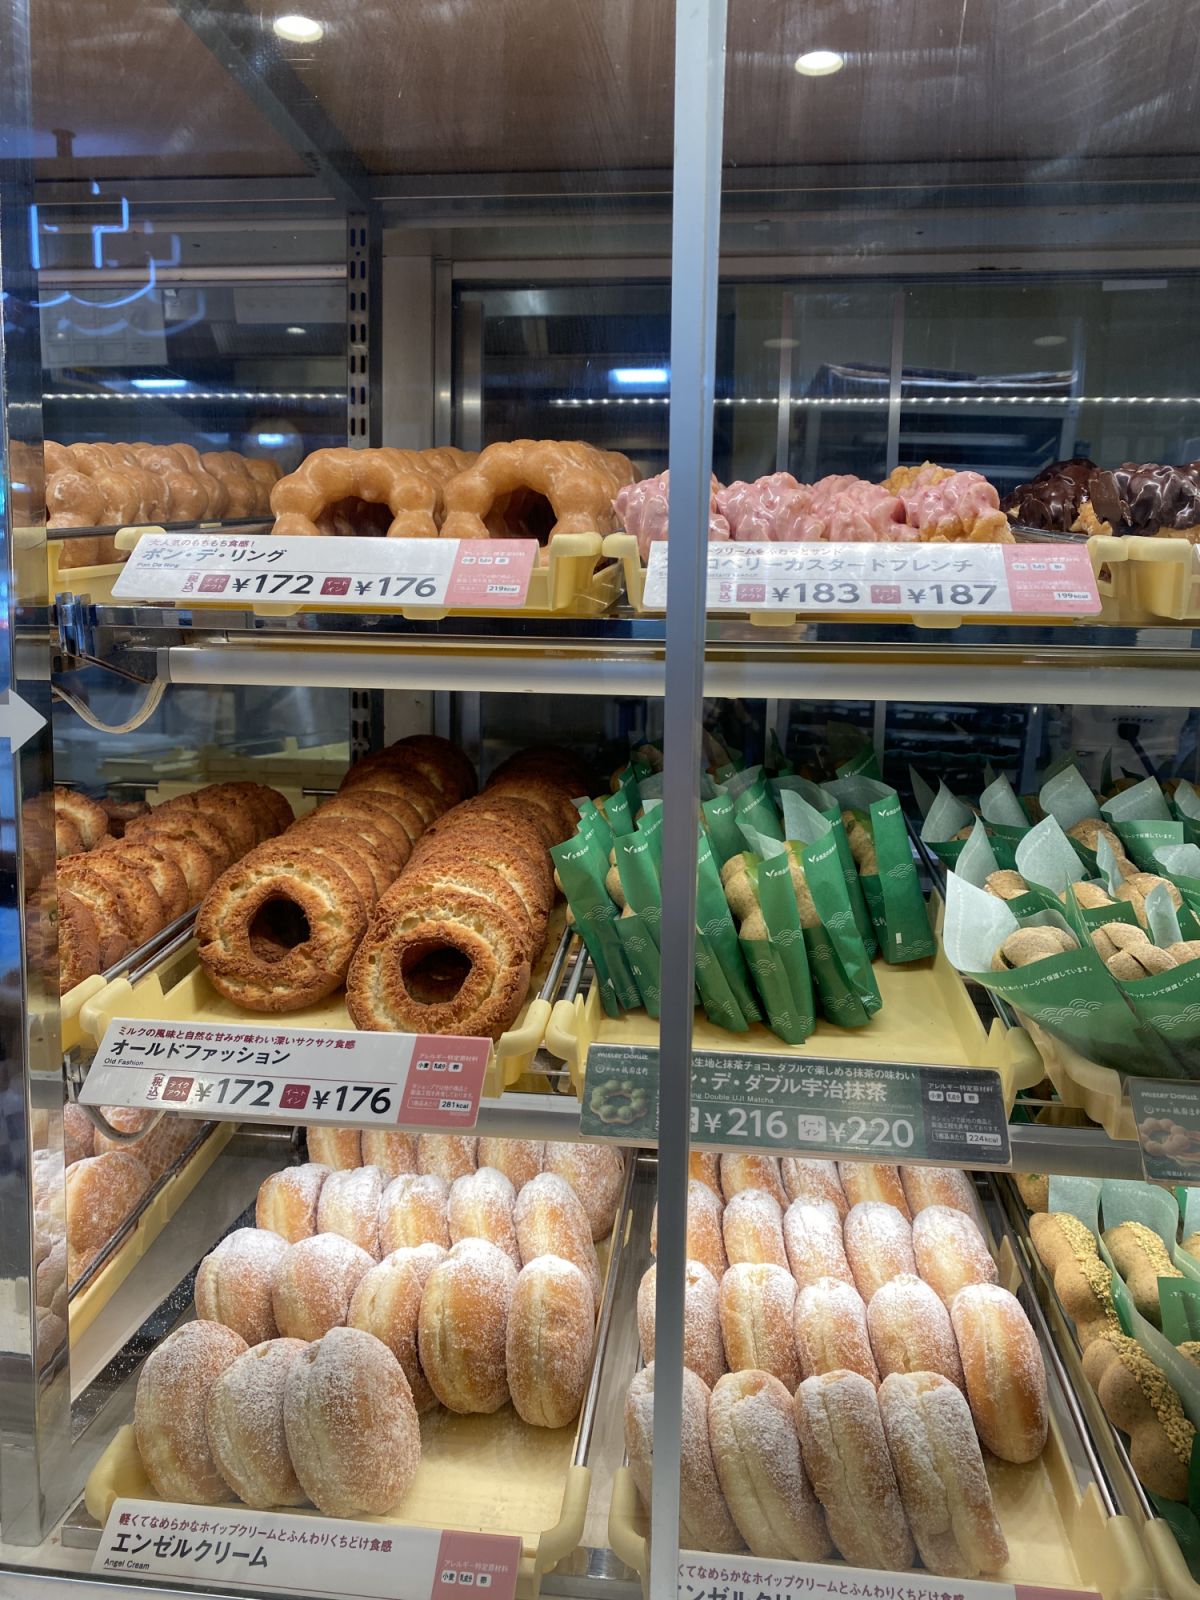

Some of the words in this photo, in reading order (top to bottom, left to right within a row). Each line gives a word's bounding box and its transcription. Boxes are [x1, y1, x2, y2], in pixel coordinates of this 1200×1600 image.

[142, 548, 287, 563] ポン・デ・リング
[232, 574, 314, 594] ¥172
[354, 576, 437, 597] ¥176
[771, 582, 860, 603] ¥183
[907, 584, 997, 605] ¥187
[118, 1025, 356, 1050] ミルクの風味と自然な甘みが味わい深いサクサク食感
[104, 1057, 116, 1065] Old
[117, 1058, 144, 1066] Fashion
[110, 1039, 291, 1065] オールドファッション
[691, 1057, 916, 1081] 生地と抹茶チョコ、ダブルで楽しめる抹茶の味わい
[166, 1089, 187, 1098] アウト
[169, 1081, 190, 1089] テイク
[194, 1078, 274, 1107] ¥172
[286, 1096, 302, 1105] イン
[312, 1085, 391, 1114] ¥176
[441, 1101, 469, 1109] 281kcal
[704, 1093, 730, 1101] Double
[748, 1096, 775, 1104] Matcha
[704, 1107, 788, 1139] ¥216
[804, 1127, 820, 1136] イン
[829, 1116, 914, 1148] ¥220
[118, 1512, 393, 1553] 軽くてなめらかなホイップクリームとふんわりくちどけ食感
[110, 1533, 268, 1568] エンゼルクリーム
[104, 1558, 125, 1568] Angel
[126, 1560, 150, 1570] Cream
